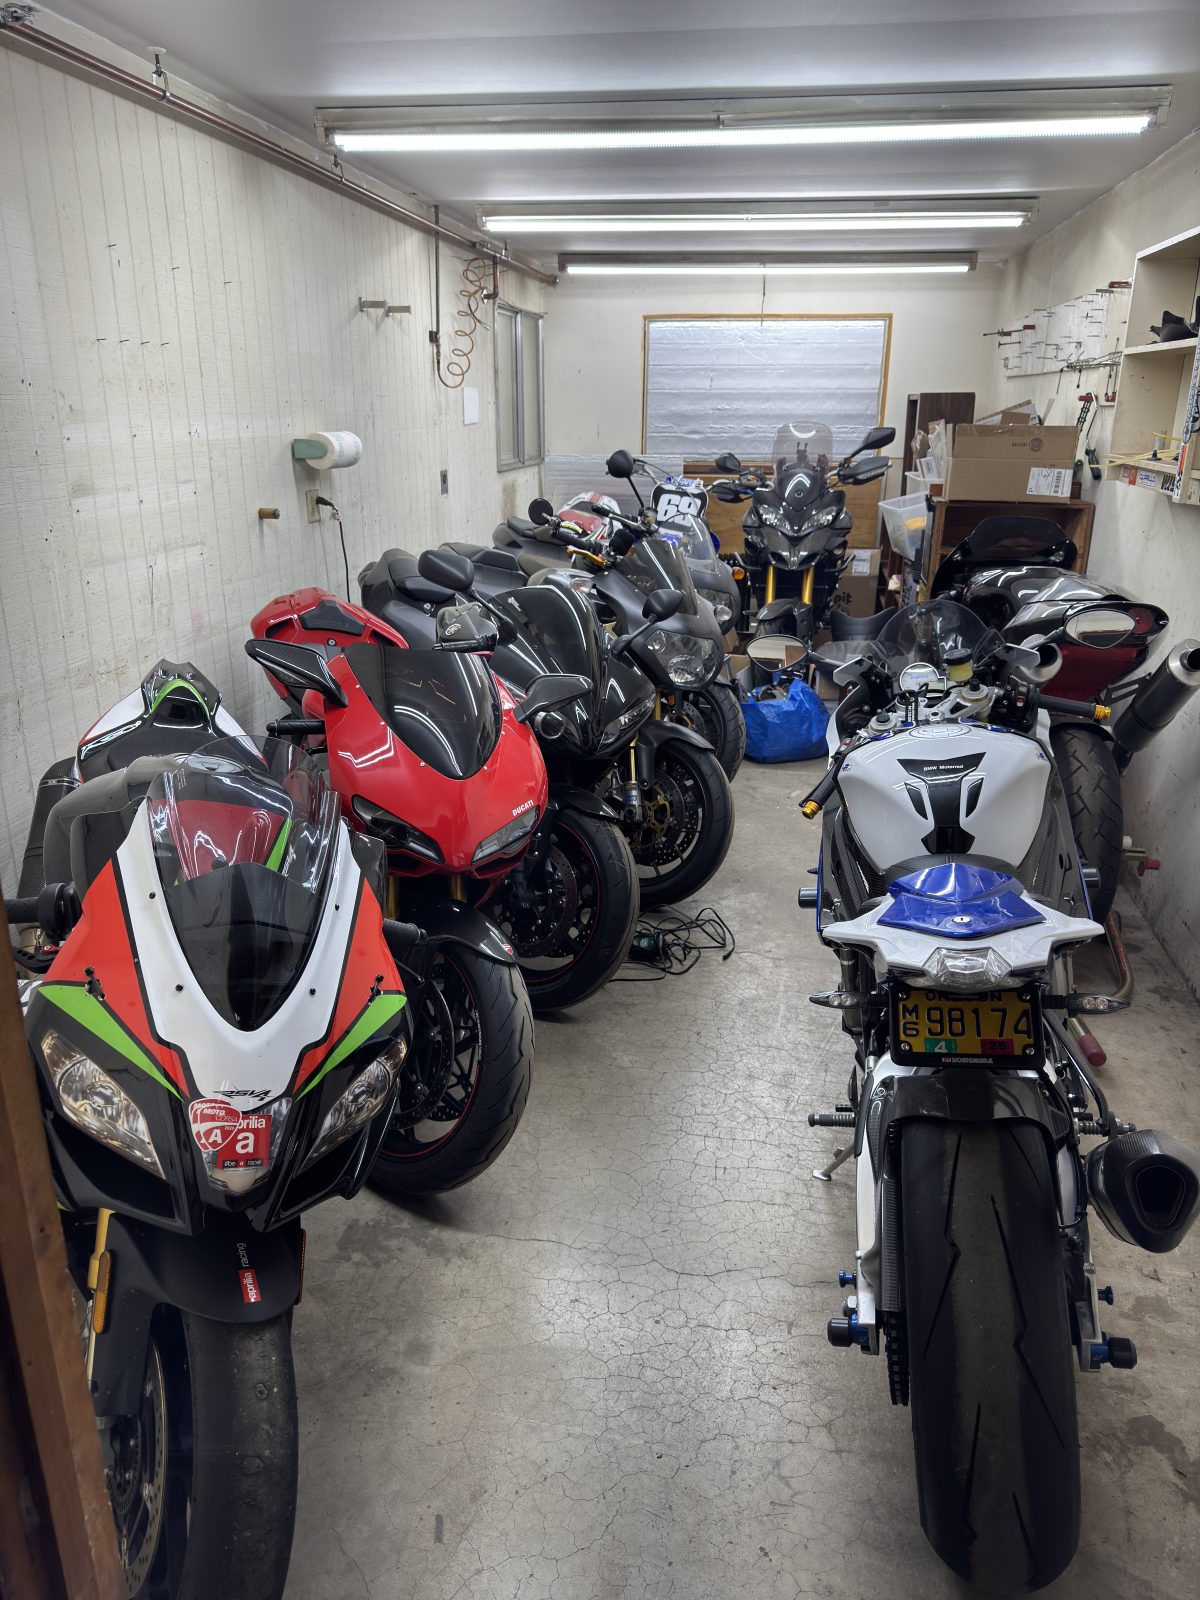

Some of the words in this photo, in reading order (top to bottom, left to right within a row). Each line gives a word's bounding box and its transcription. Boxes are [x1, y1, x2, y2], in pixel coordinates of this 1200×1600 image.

[656, 493, 702, 527] 69
[512, 799, 534, 817] DUCATI
[926, 1006, 1033, 1040] 98174
[934, 1040, 948, 1053] 4
[202, 1108, 226, 1116] MOTO
[215, 1115, 238, 1123] CORSA
[208, 1128, 223, 1144] A
[235, 1131, 255, 1154] a
[236, 1242, 250, 1267] racing
[243, 1272, 257, 1299] aprilia
